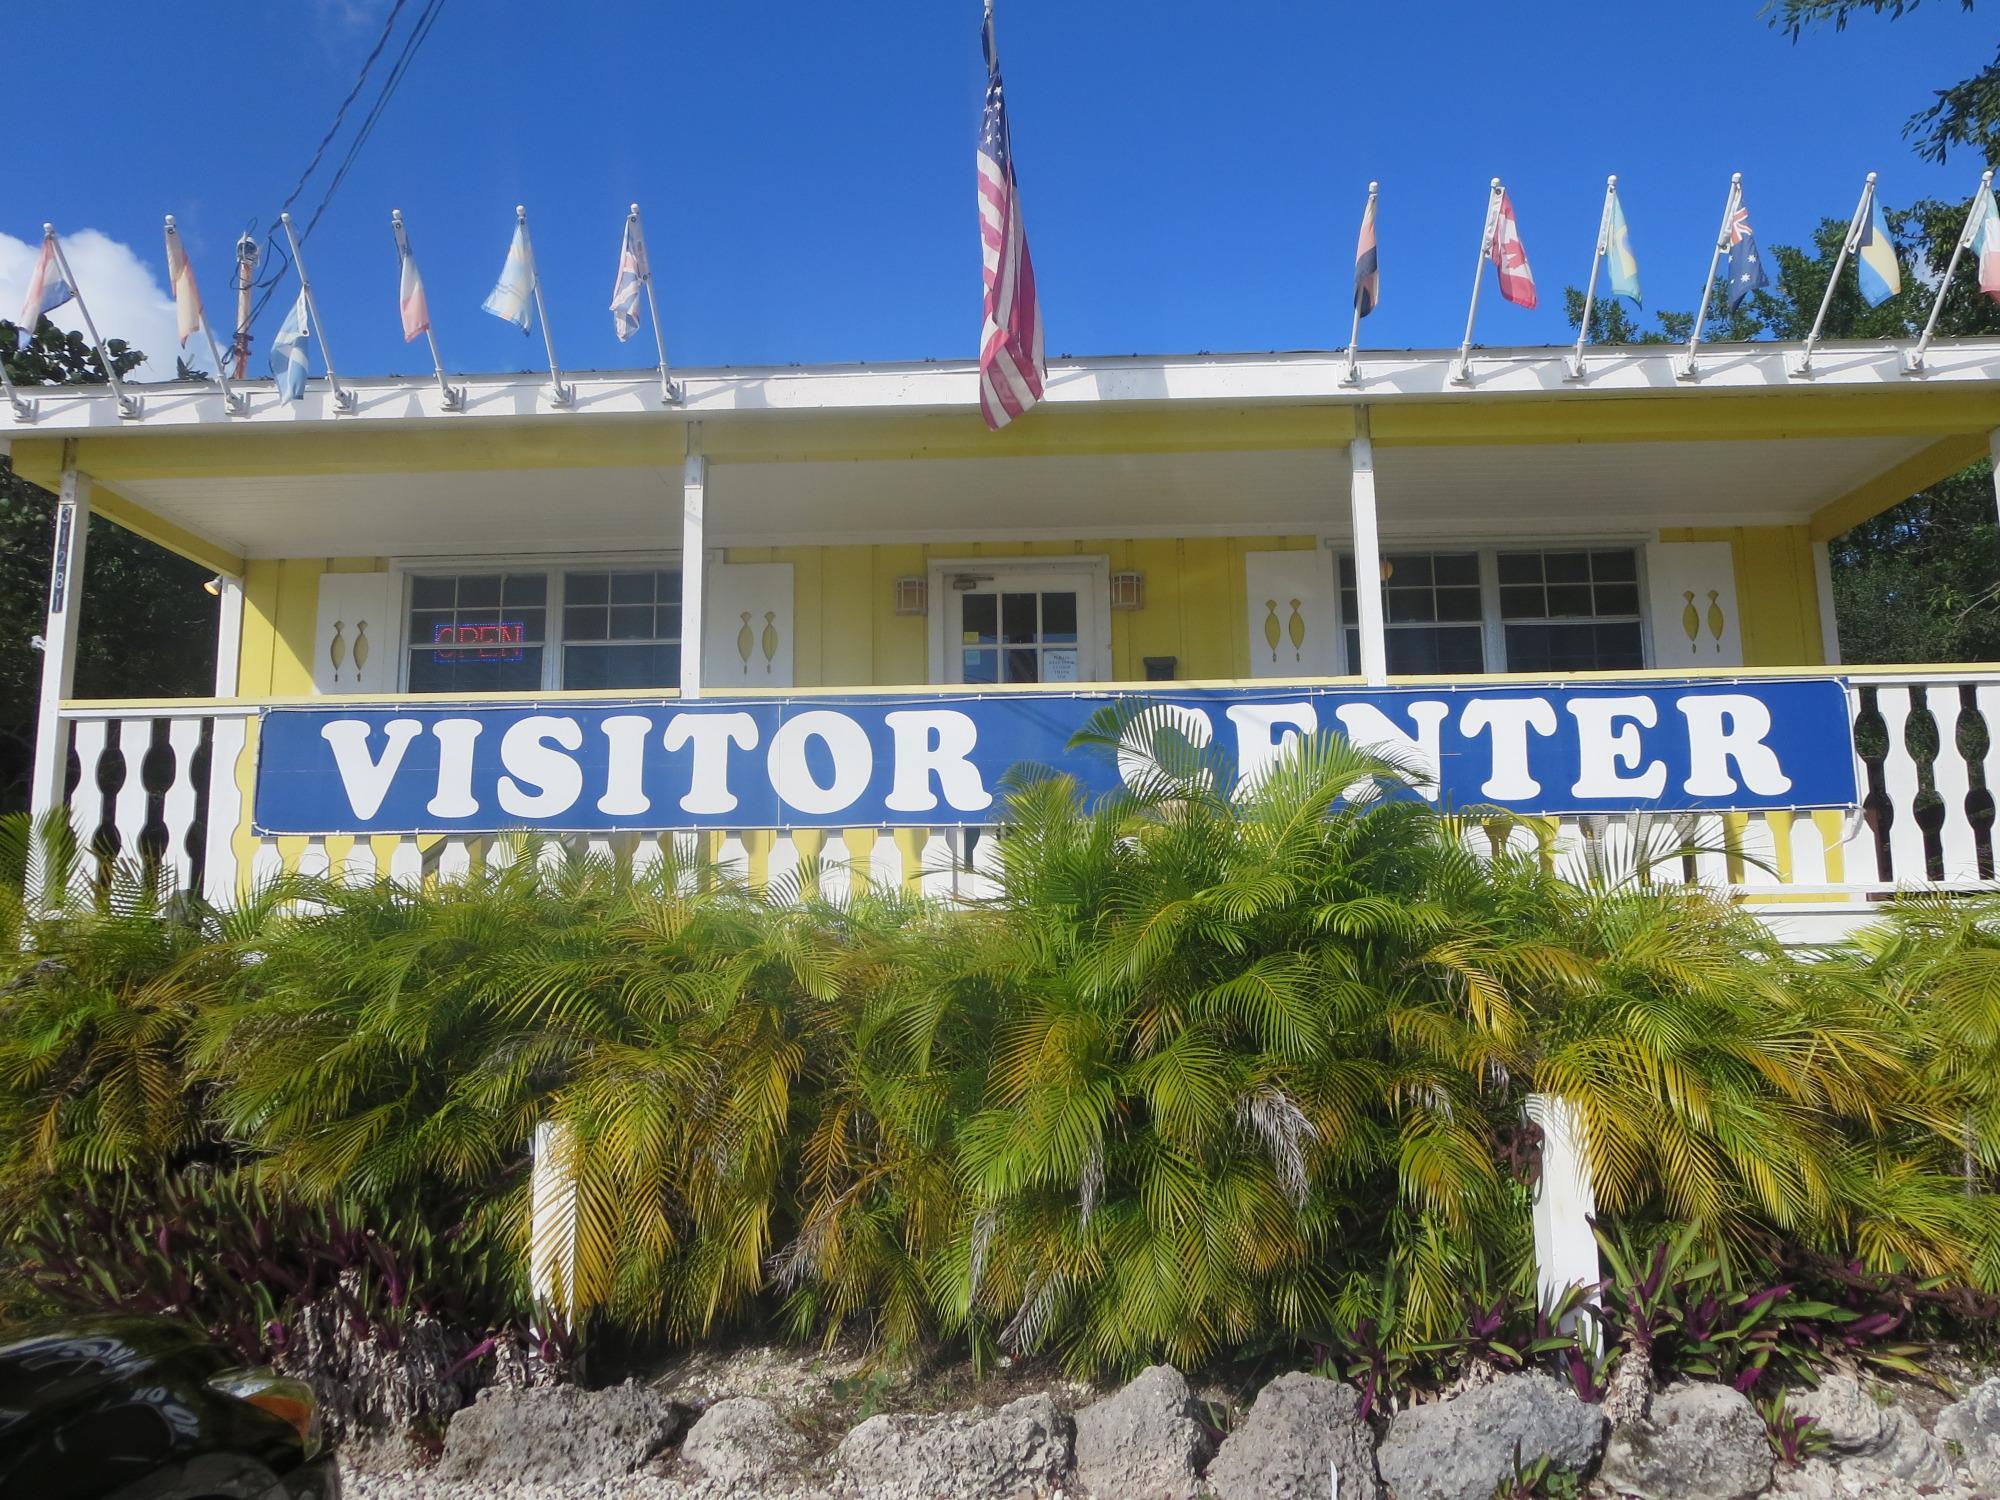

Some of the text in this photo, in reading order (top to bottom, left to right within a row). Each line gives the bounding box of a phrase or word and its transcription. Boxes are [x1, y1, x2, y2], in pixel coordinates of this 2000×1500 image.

[54, 507, 71, 611] 31281
[437, 626, 523, 658] OPEN
[320, 694, 1792, 821] VISITOR CENTER
